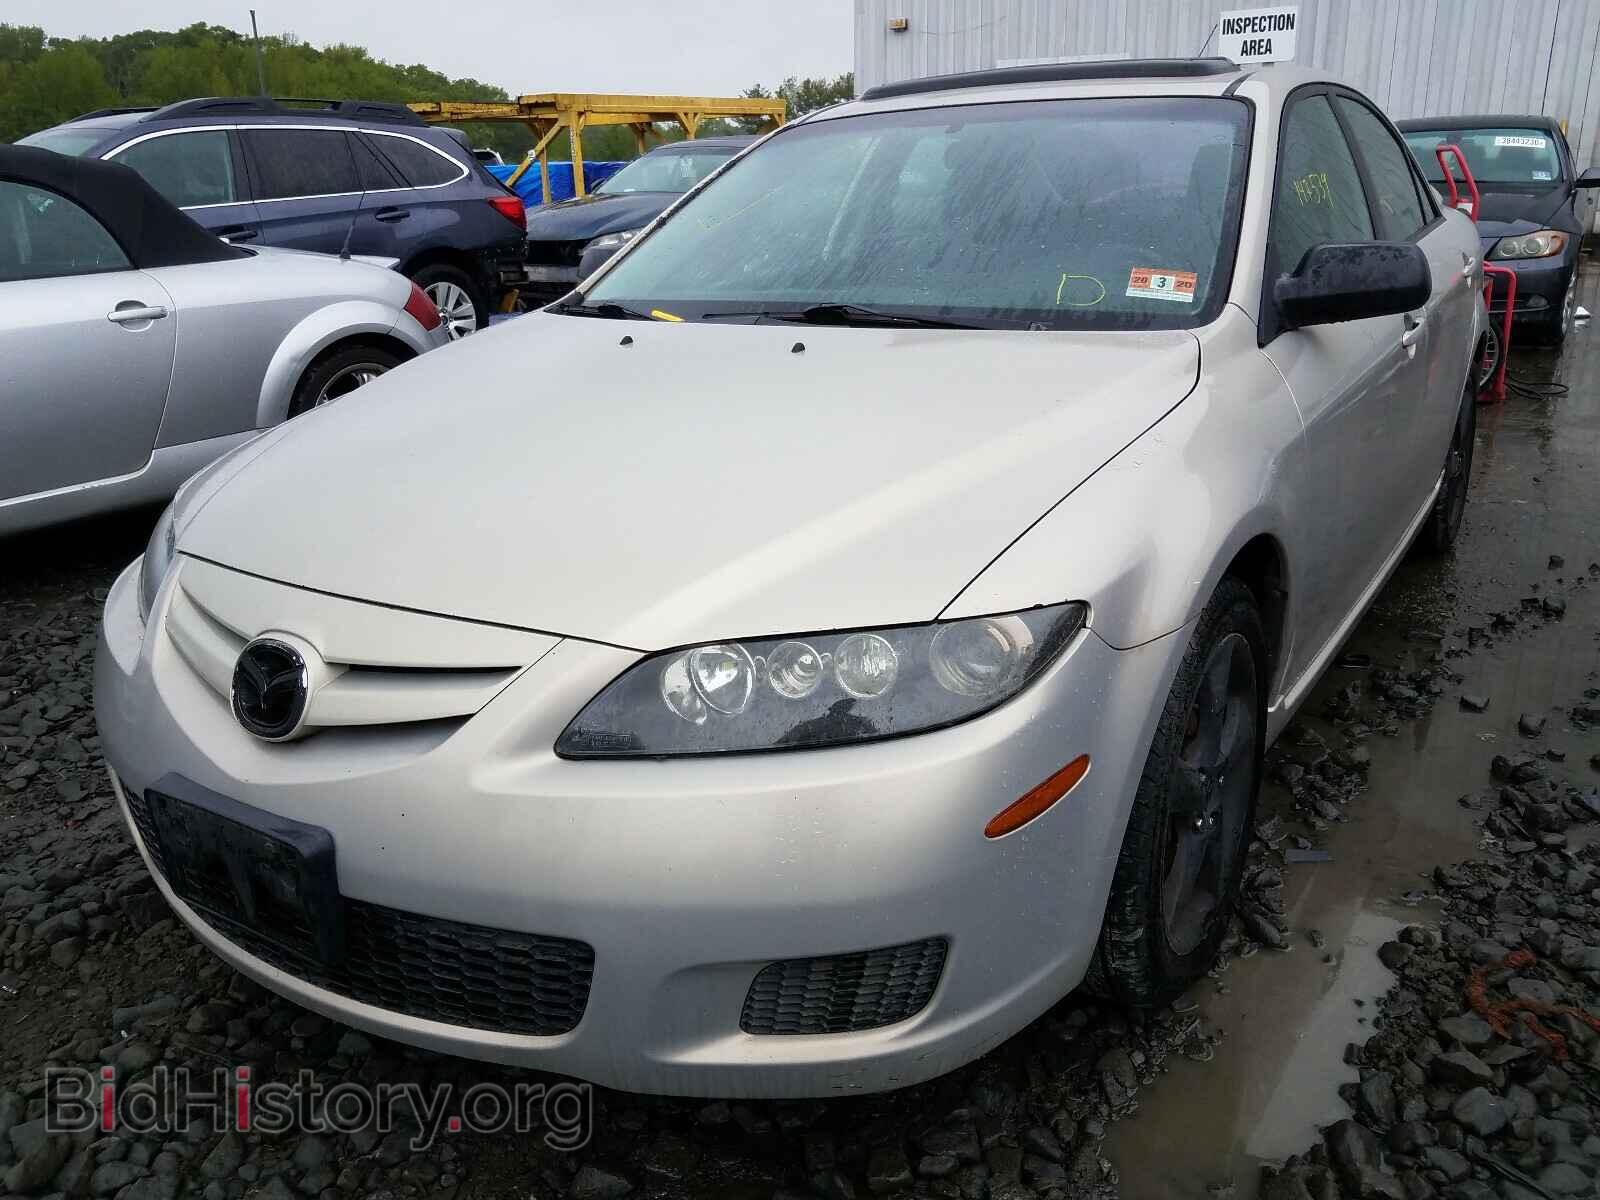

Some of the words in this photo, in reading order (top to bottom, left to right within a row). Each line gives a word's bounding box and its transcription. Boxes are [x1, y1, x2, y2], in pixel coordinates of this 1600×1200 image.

[1222, 13, 1296, 35] INSPECTION
[1240, 38, 1273, 56] AREA
[1056, 273, 1106, 306] D
[1158, 277, 1167, 288] 3
[1176, 280, 1193, 289] 20
